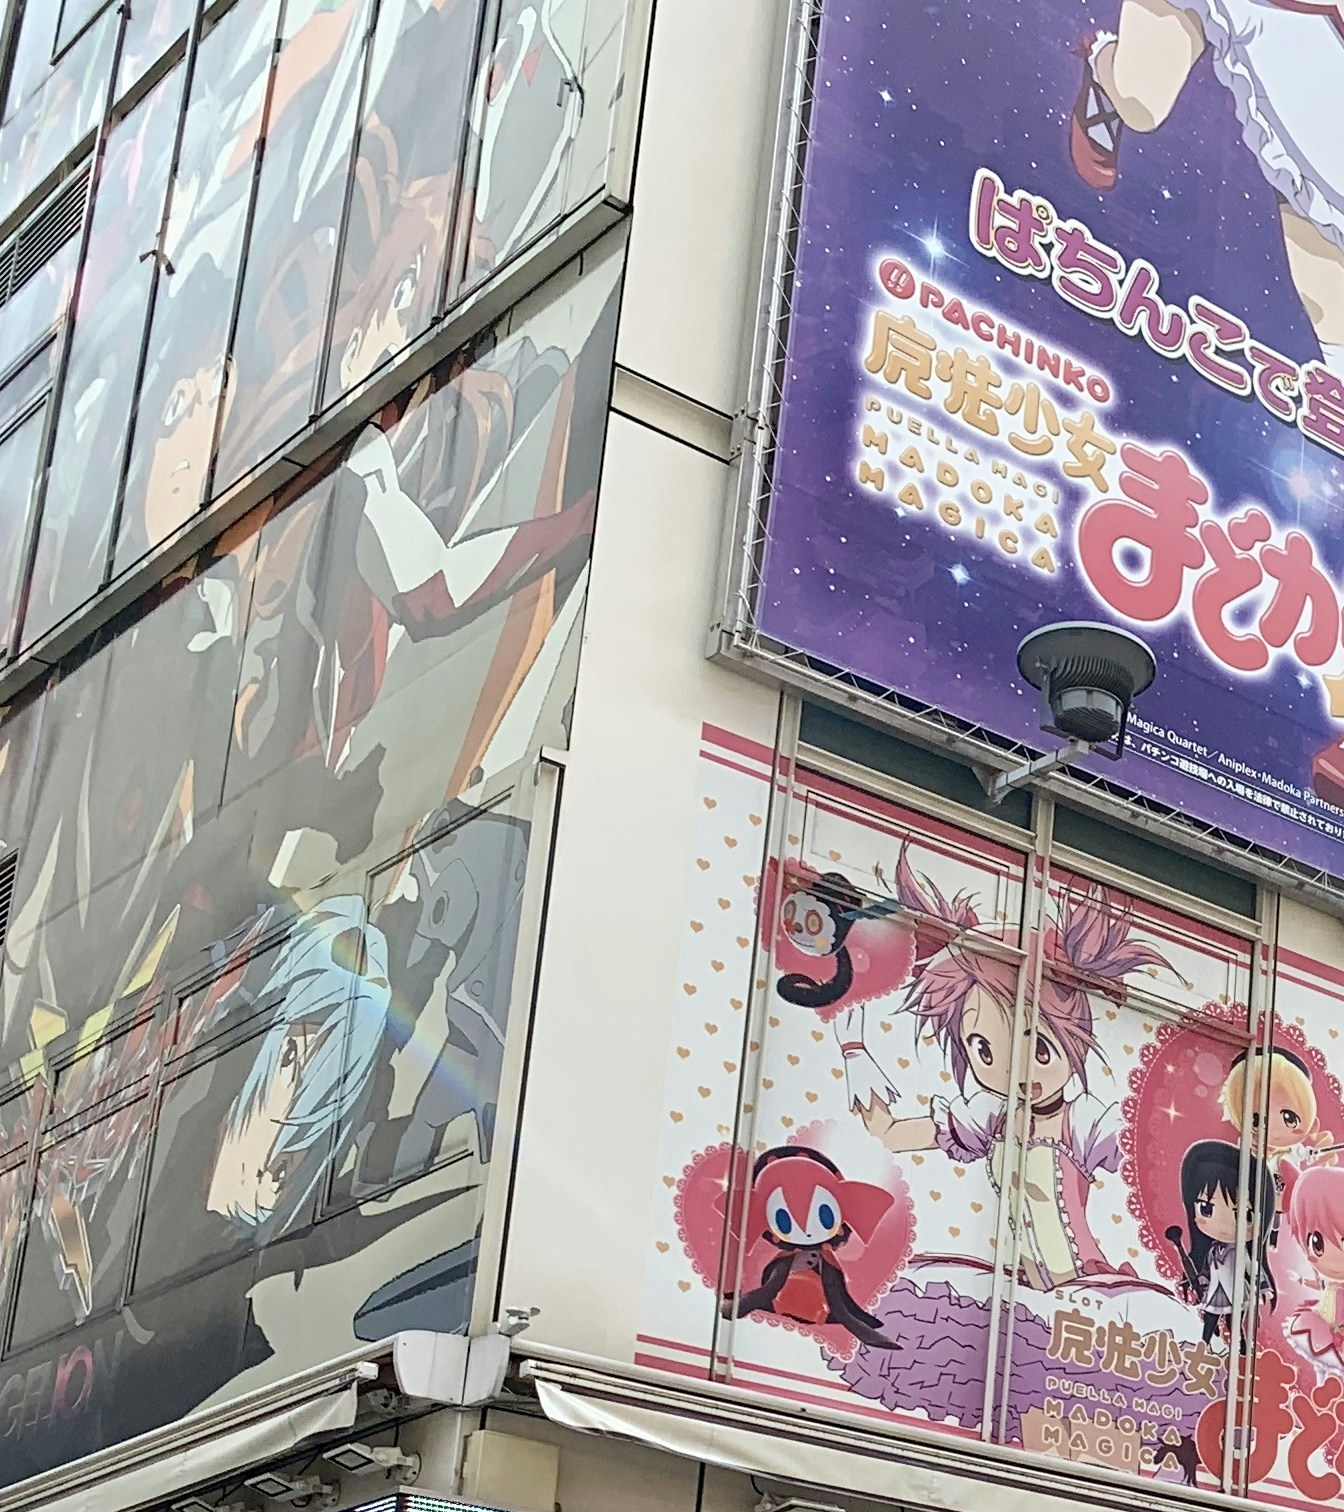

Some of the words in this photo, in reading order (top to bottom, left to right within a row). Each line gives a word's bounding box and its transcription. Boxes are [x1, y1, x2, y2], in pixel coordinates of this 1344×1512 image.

[920, 282, 1110, 403] PACHINKO
[863, 424, 1058, 538] MADOKA
[859, 460, 1055, 574] MAGICA
[1054, 1289, 1104, 1311] SLOT
[1046, 1375, 1128, 1408] PUELLA
[1132, 1396, 1183, 1420] MAGI
[1044, 1398, 1183, 1447] MADOKA
[1042, 1424, 1180, 1472] MAGICA
